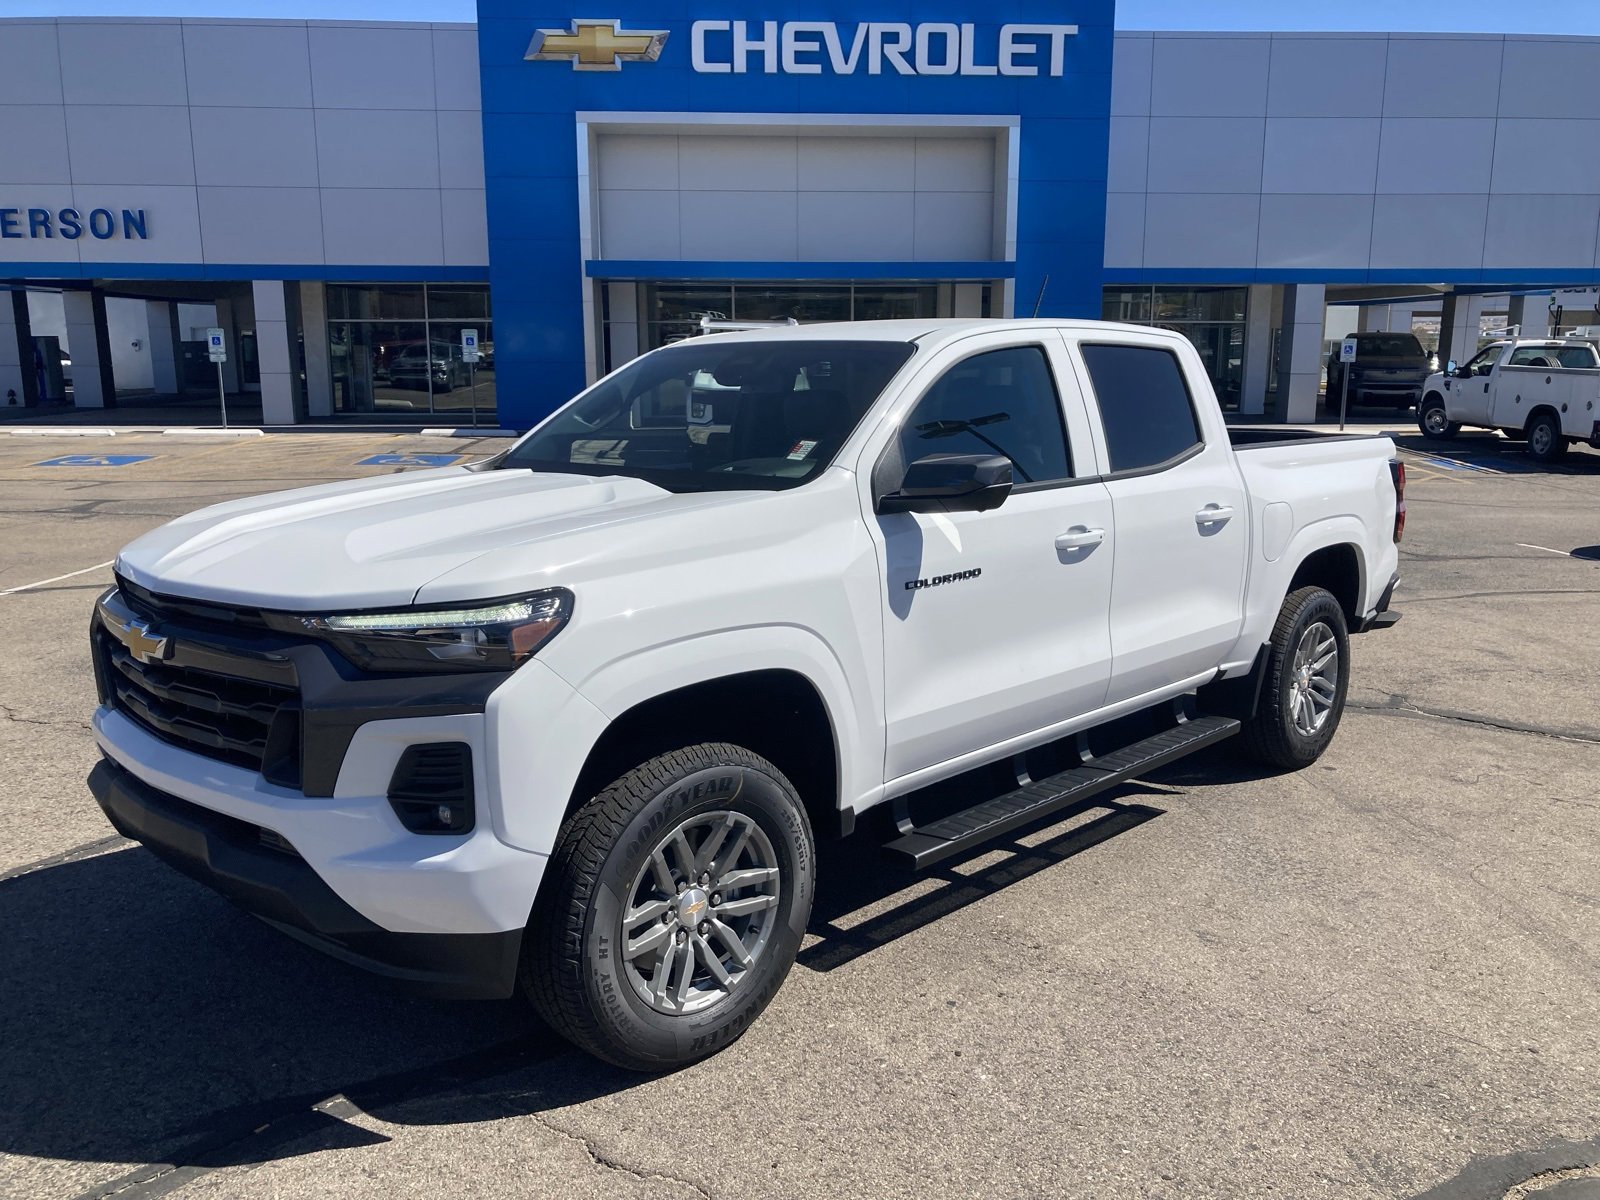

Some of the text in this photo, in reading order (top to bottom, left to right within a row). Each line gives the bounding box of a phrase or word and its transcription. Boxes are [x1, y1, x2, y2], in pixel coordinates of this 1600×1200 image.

[691, 20, 1079, 77] CHEVROLET
[0, 208, 148, 239] ERSON
[905, 568, 982, 590] COLORADO
[616, 776, 734, 877] GOODYEAR
[599, 935, 609, 960] HT
